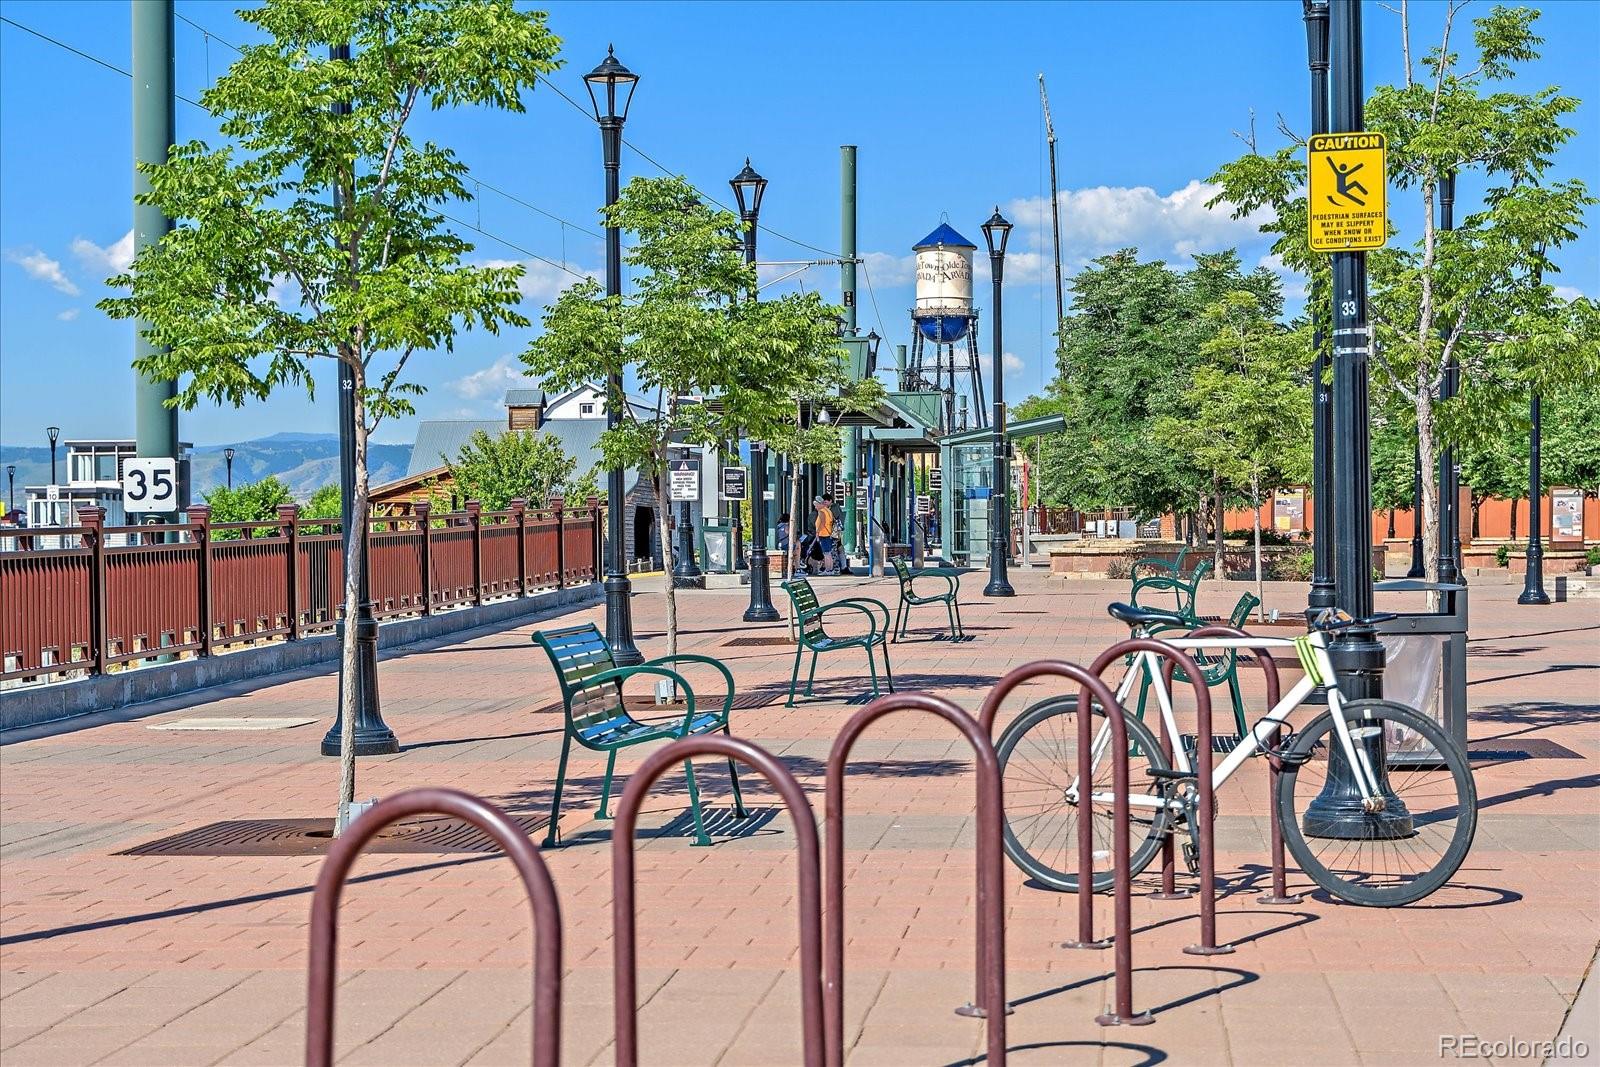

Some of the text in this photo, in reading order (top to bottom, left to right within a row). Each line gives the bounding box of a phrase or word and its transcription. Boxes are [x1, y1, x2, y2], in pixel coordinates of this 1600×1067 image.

[1314, 135, 1379, 150] CAUTION
[1352, 211, 1383, 219] SURFACES
[1341, 301, 1357, 316] 33
[342, 379, 353, 390] 32
[1319, 393, 1328, 402] 31
[127, 469, 173, 501] 35
[49, 493, 57, 501] 10
